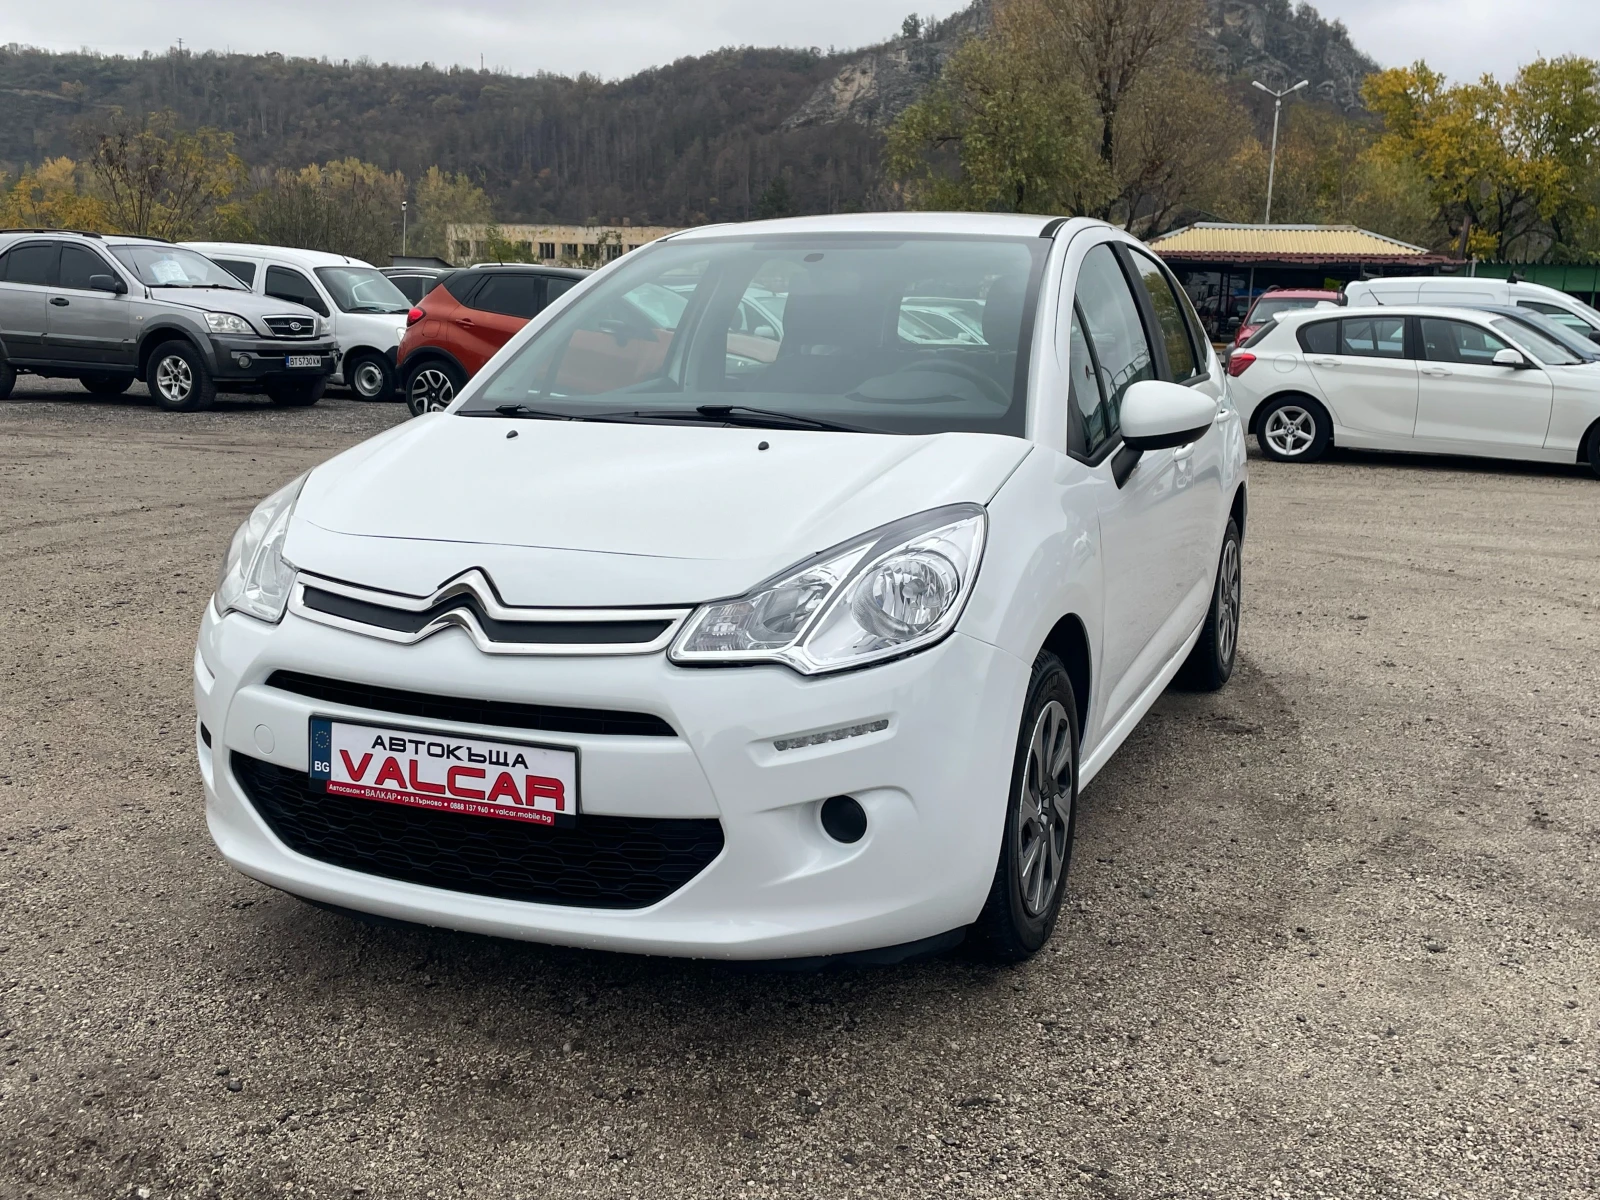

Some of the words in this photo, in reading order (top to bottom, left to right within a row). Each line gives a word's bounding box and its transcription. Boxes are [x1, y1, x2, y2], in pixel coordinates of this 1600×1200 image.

[290, 357, 297, 365] BT
[299, 357, 312, 365] 5730
[314, 760, 330, 773] BG
[371, 735, 529, 769] АВТОКЪЩА
[339, 749, 565, 811] VALCAR
[329, 784, 360, 794] Автосалон
[365, 789, 397, 800] ВАЛКАР
[450, 802, 464, 810] 0888
[465, 804, 476, 812] 137
[495, 808, 552, 823] valcar.mobile.bg
